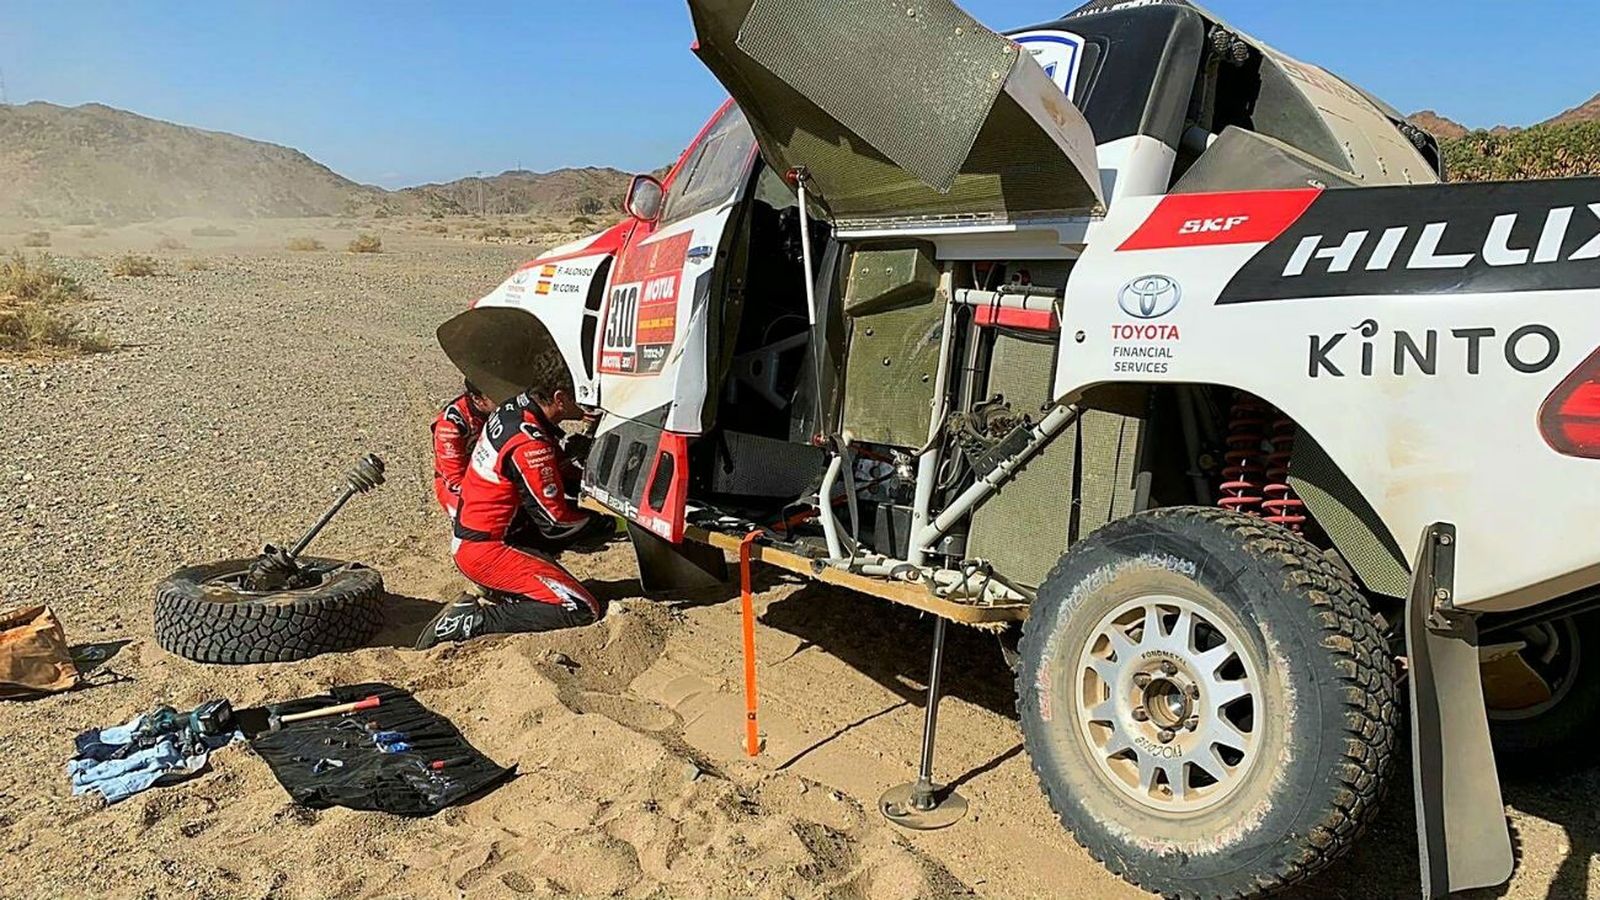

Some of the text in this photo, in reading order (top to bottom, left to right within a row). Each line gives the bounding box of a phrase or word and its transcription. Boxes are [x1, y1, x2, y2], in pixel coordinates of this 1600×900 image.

[1178, 216, 1249, 234] SKF
[564, 267, 592, 277] ALONSO
[643, 275, 676, 302] MOTUL
[607, 286, 638, 348] 310
[1112, 325, 1180, 341] TOYOTA
[1113, 346, 1173, 359] FINANCIAL
[1113, 362, 1168, 373] SERVICES
